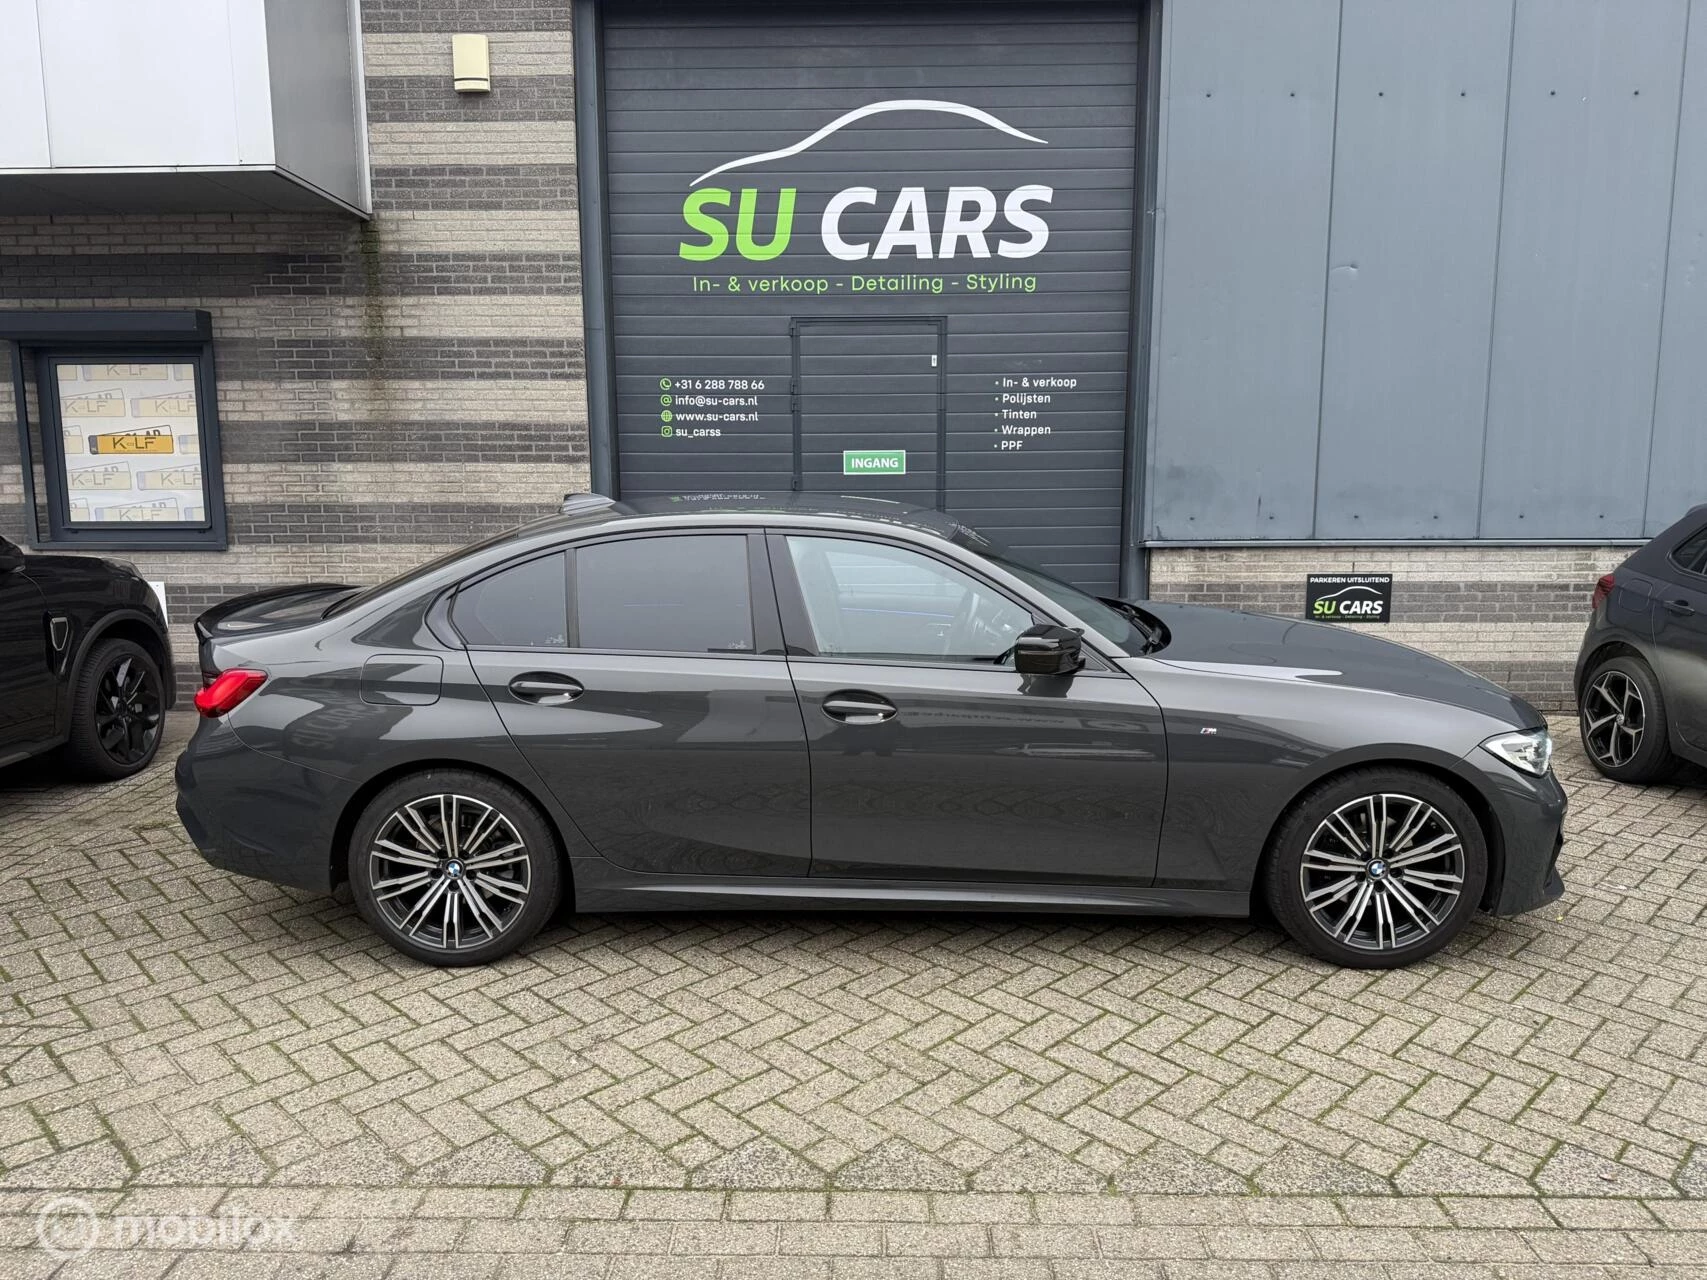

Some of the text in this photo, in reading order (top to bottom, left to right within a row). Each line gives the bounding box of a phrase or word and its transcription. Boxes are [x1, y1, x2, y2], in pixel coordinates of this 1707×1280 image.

[679, 184, 1054, 261] SU CARS
[692, 275, 720, 292] In-
[728, 275, 742, 292] &
[748, 274, 829, 294] verkoop
[851, 274, 944, 294] Detailing
[966, 273, 1037, 293] Styling
[674, 379, 765, 390] +31 6 288 788 66
[1002, 377, 1077, 389] In- & verkoop
[675, 395, 758, 407] info@su-cars.nl
[1002, 393, 1051, 405] Polijsten
[675, 411, 759, 421] www.su-cars.nl
[1002, 409, 1037, 419] Tinten
[675, 428, 721, 438] su_carss
[1001, 425, 1051, 436] Wrappen
[1001, 441, 1023, 450] PPF
[851, 458, 898, 468] INGANG
[1313, 600, 1384, 615] SU CARS
